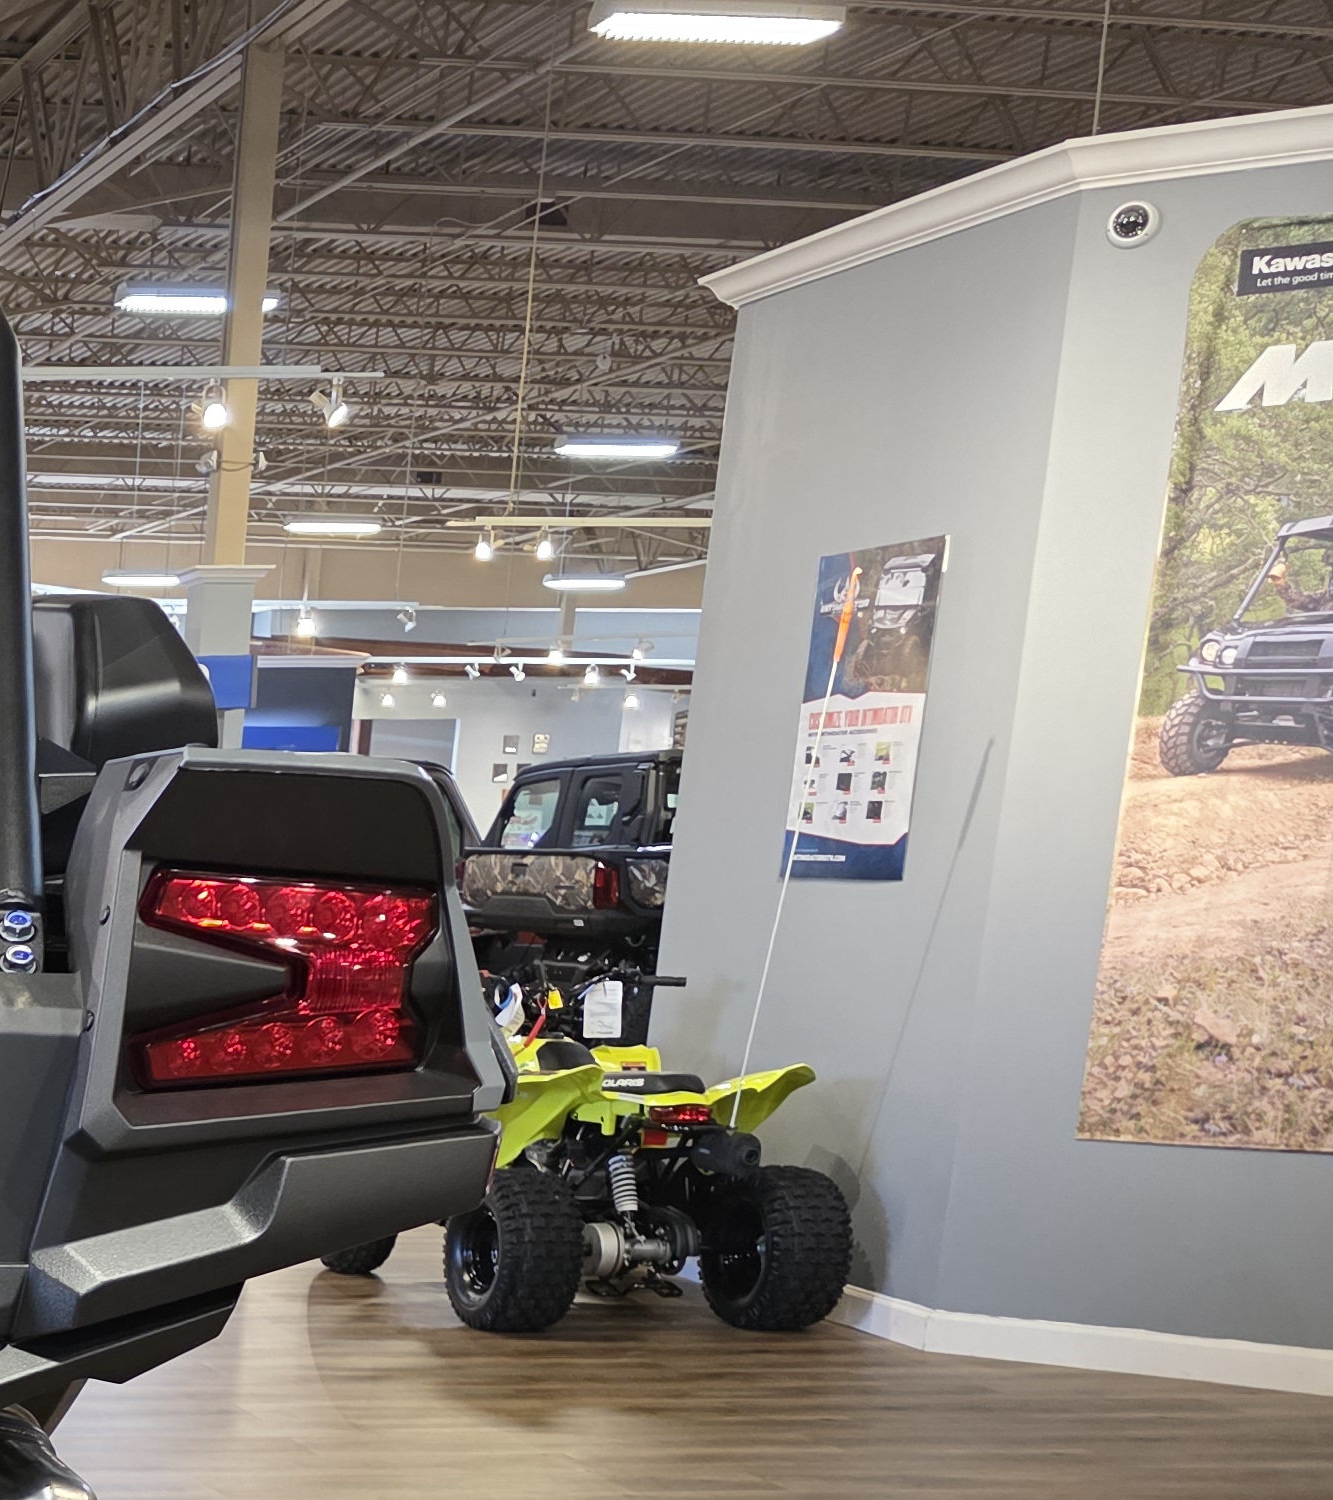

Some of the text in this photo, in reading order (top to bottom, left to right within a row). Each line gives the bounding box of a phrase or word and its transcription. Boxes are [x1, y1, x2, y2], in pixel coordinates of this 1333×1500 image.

[1256, 278, 1272, 287] Let
[1274, 276, 1290, 285] the
[1292, 272, 1318, 285] good
